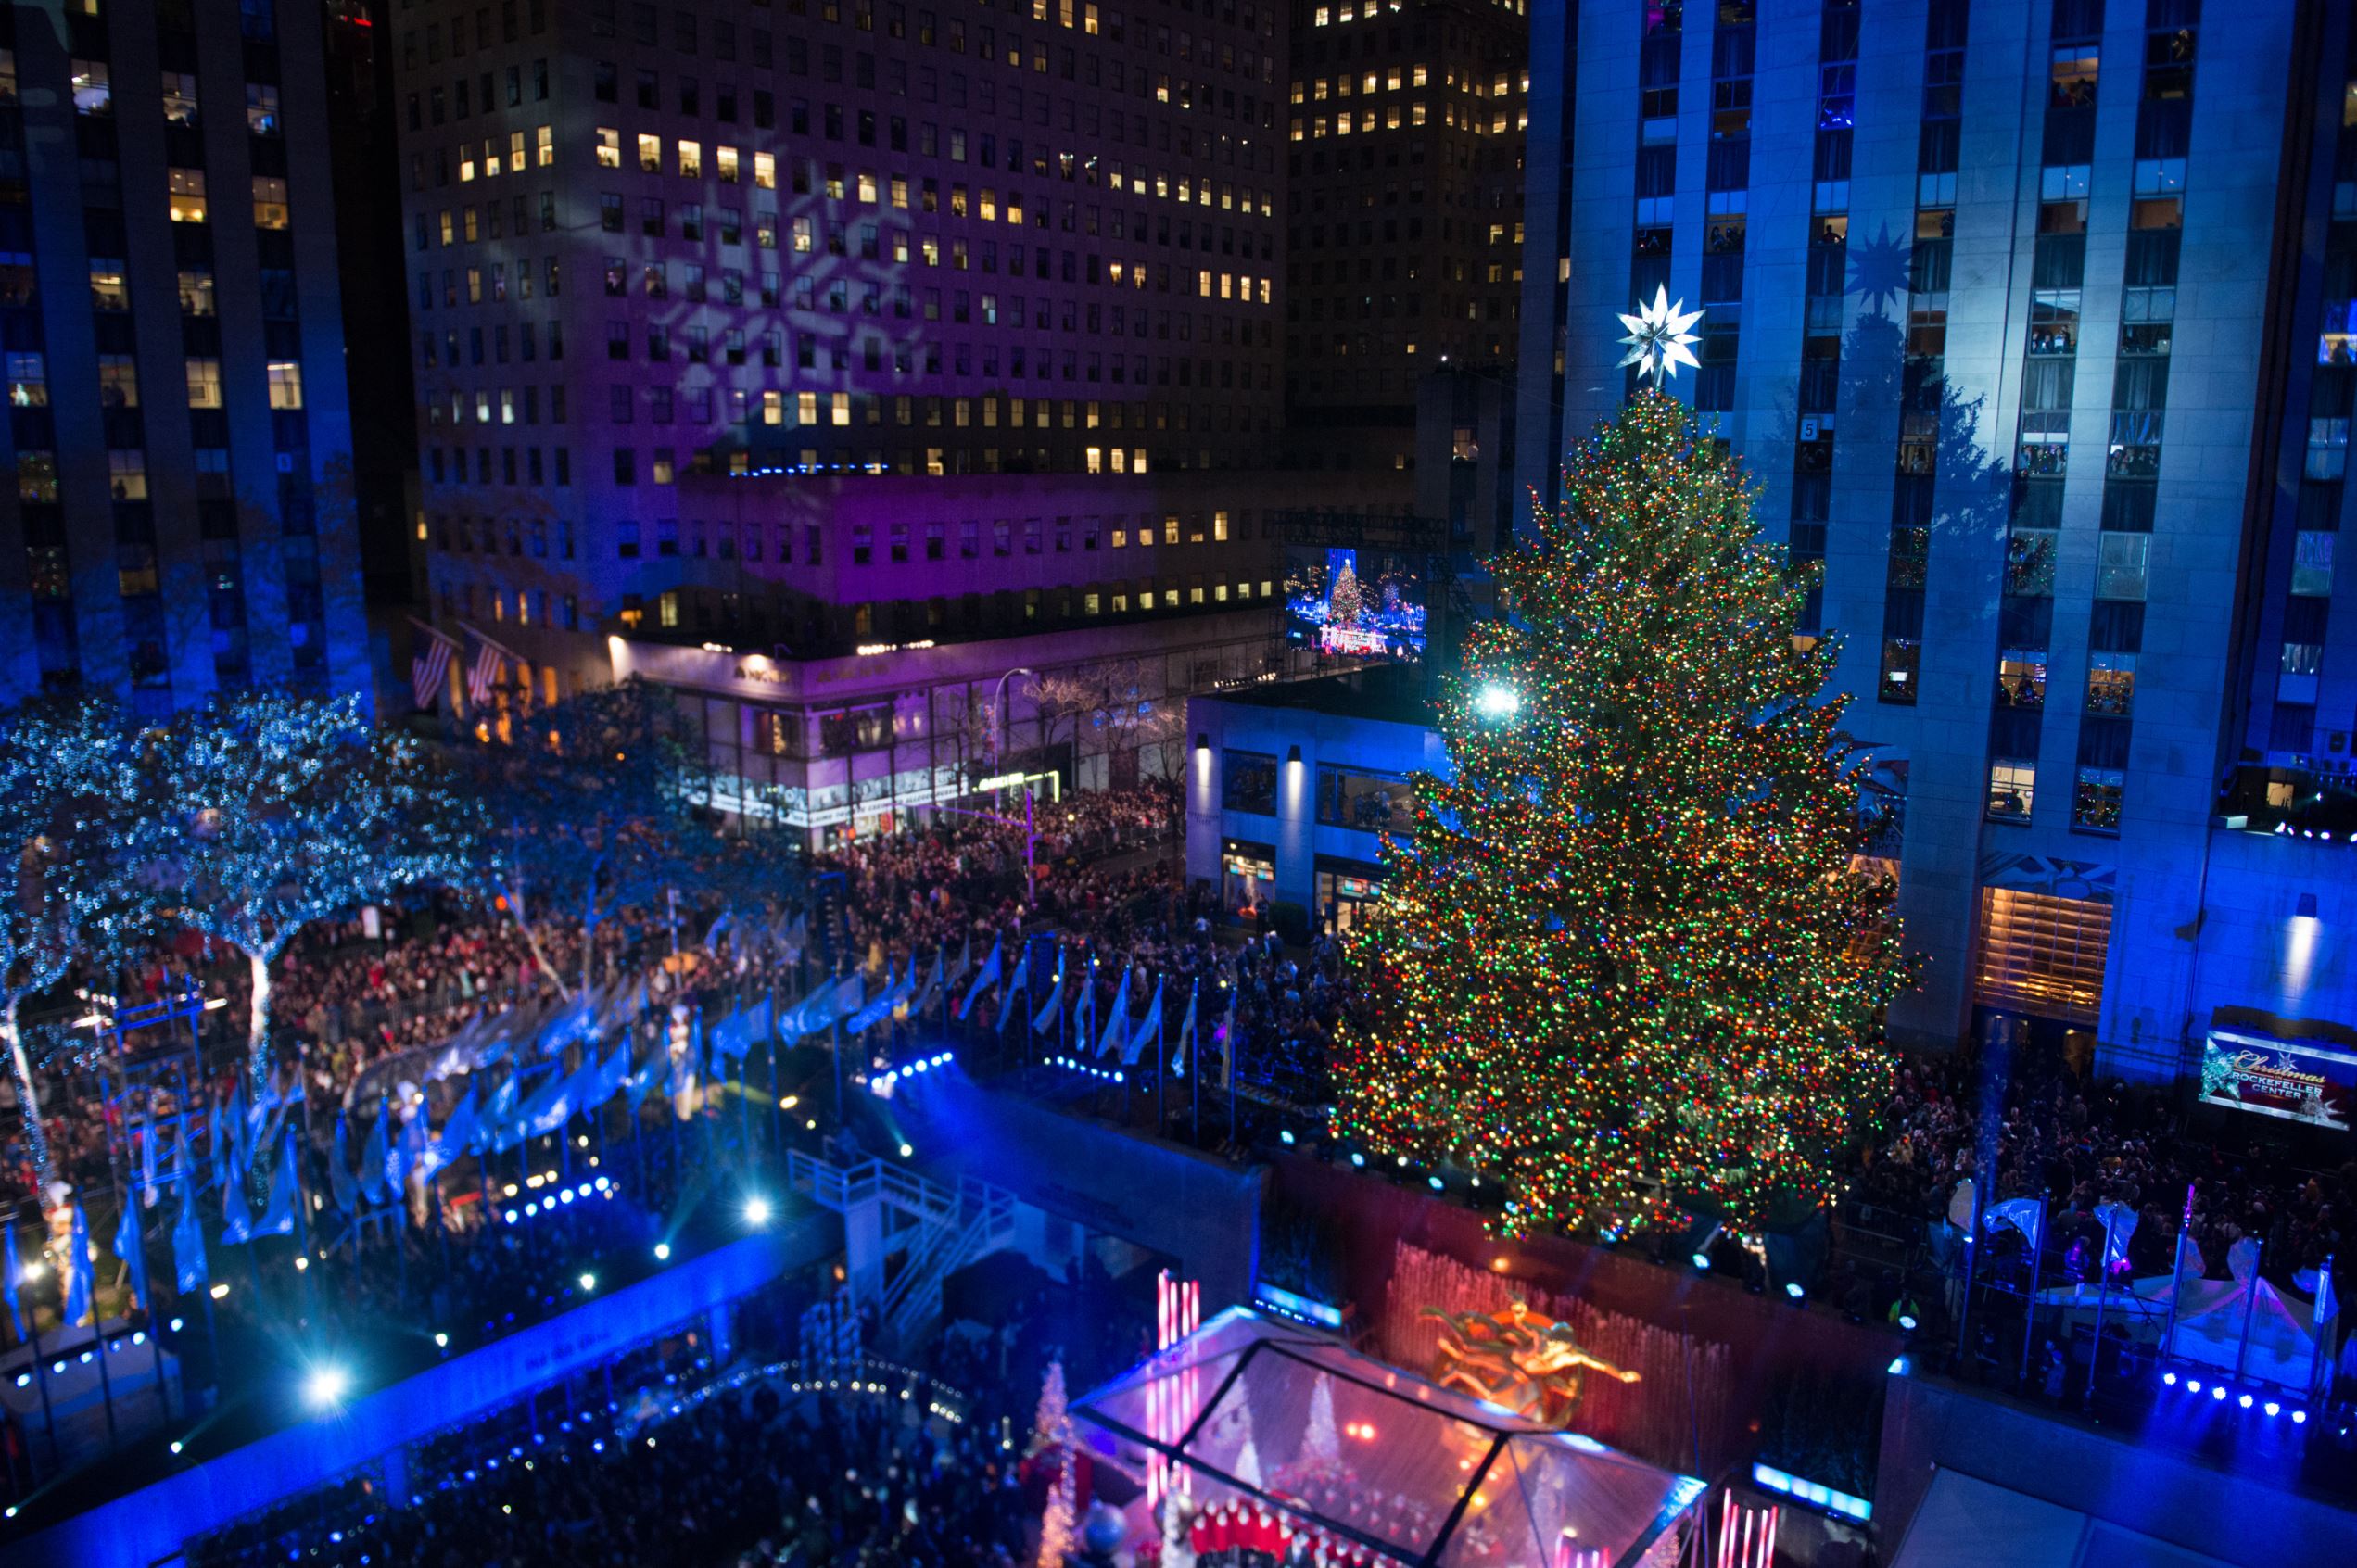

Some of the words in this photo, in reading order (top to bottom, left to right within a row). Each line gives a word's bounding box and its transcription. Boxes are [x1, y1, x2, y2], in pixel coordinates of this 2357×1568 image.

[1805, 423, 1814, 437] 5
[2234, 1050, 2326, 1083] Christmas
[2232, 1071, 2323, 1097] ROCKEFELLER
[2251, 1083, 2301, 1100] CENTER
